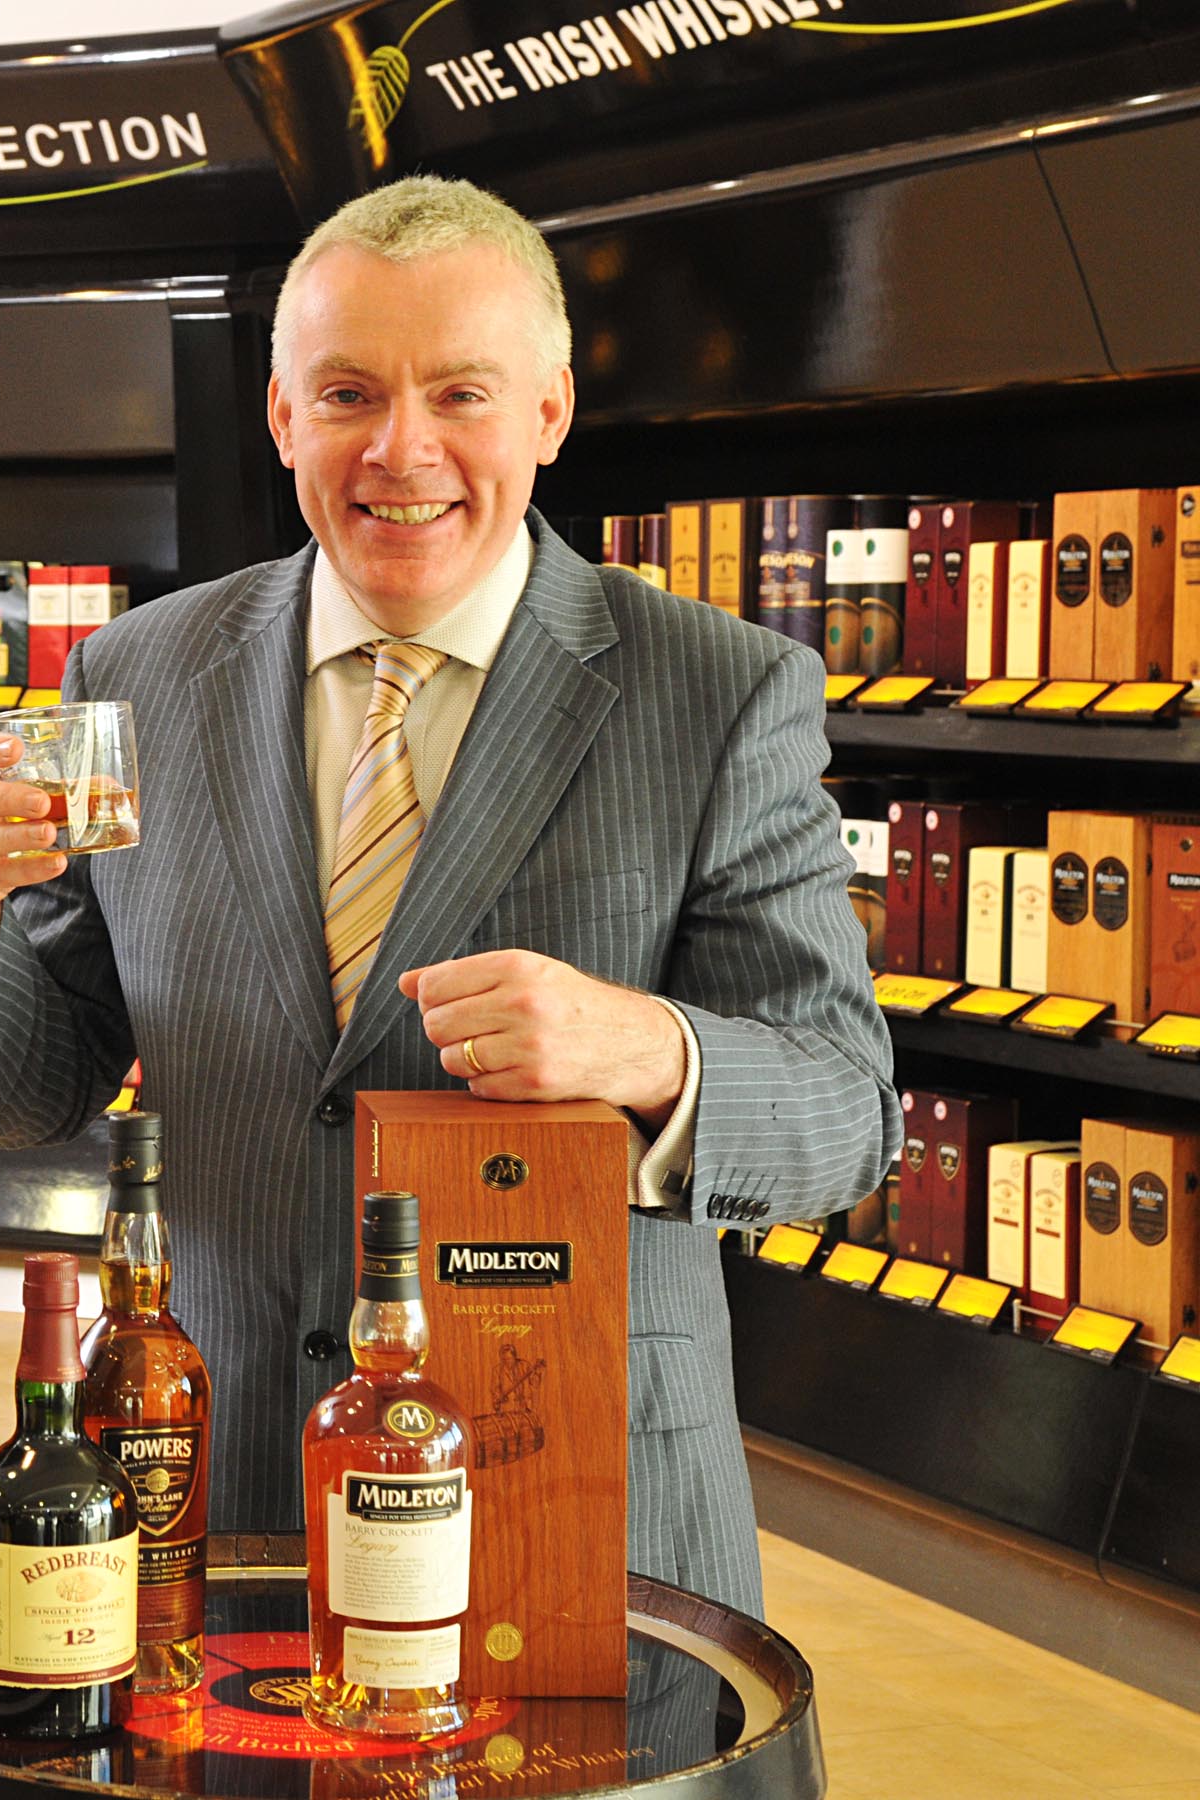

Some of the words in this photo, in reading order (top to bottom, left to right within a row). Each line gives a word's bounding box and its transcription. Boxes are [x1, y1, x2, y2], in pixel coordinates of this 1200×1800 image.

[425, 49, 518, 111] THE
[504, 15, 632, 92] IRISH
[617, 0, 844, 59] WHISK
[448, 1247, 560, 1273] MIDLETON
[453, 1304, 490, 1315] BARRY
[492, 1303, 557, 1314] CROCKETT
[480, 1316, 532, 1337] Legacy
[120, 1437, 193, 1462] POWERS
[137, 1494, 162, 1505] OHN'S
[163, 1491, 183, 1502] LANE
[357, 1483, 457, 1509] MIDLETON
[345, 1522, 375, 1535] BARRY
[380, 1527, 433, 1537] CROCKETT
[152, 1546, 197, 1561] WHISKEY
[344, 1534, 400, 1553] Legacy
[20, 1551, 128, 1585] REDBREAST
[31, 1608, 72, 1616] SINGLE
[76, 1606, 94, 1614] POT
[64, 1627, 97, 1647] 12
[237, 1736, 355, 1753] Bodied
[373, 1768, 427, 1785] The
[533, 1741, 559, 1758] of
[491, 1762, 551, 1785] Irish
[553, 1745, 657, 1771] Whiskey
